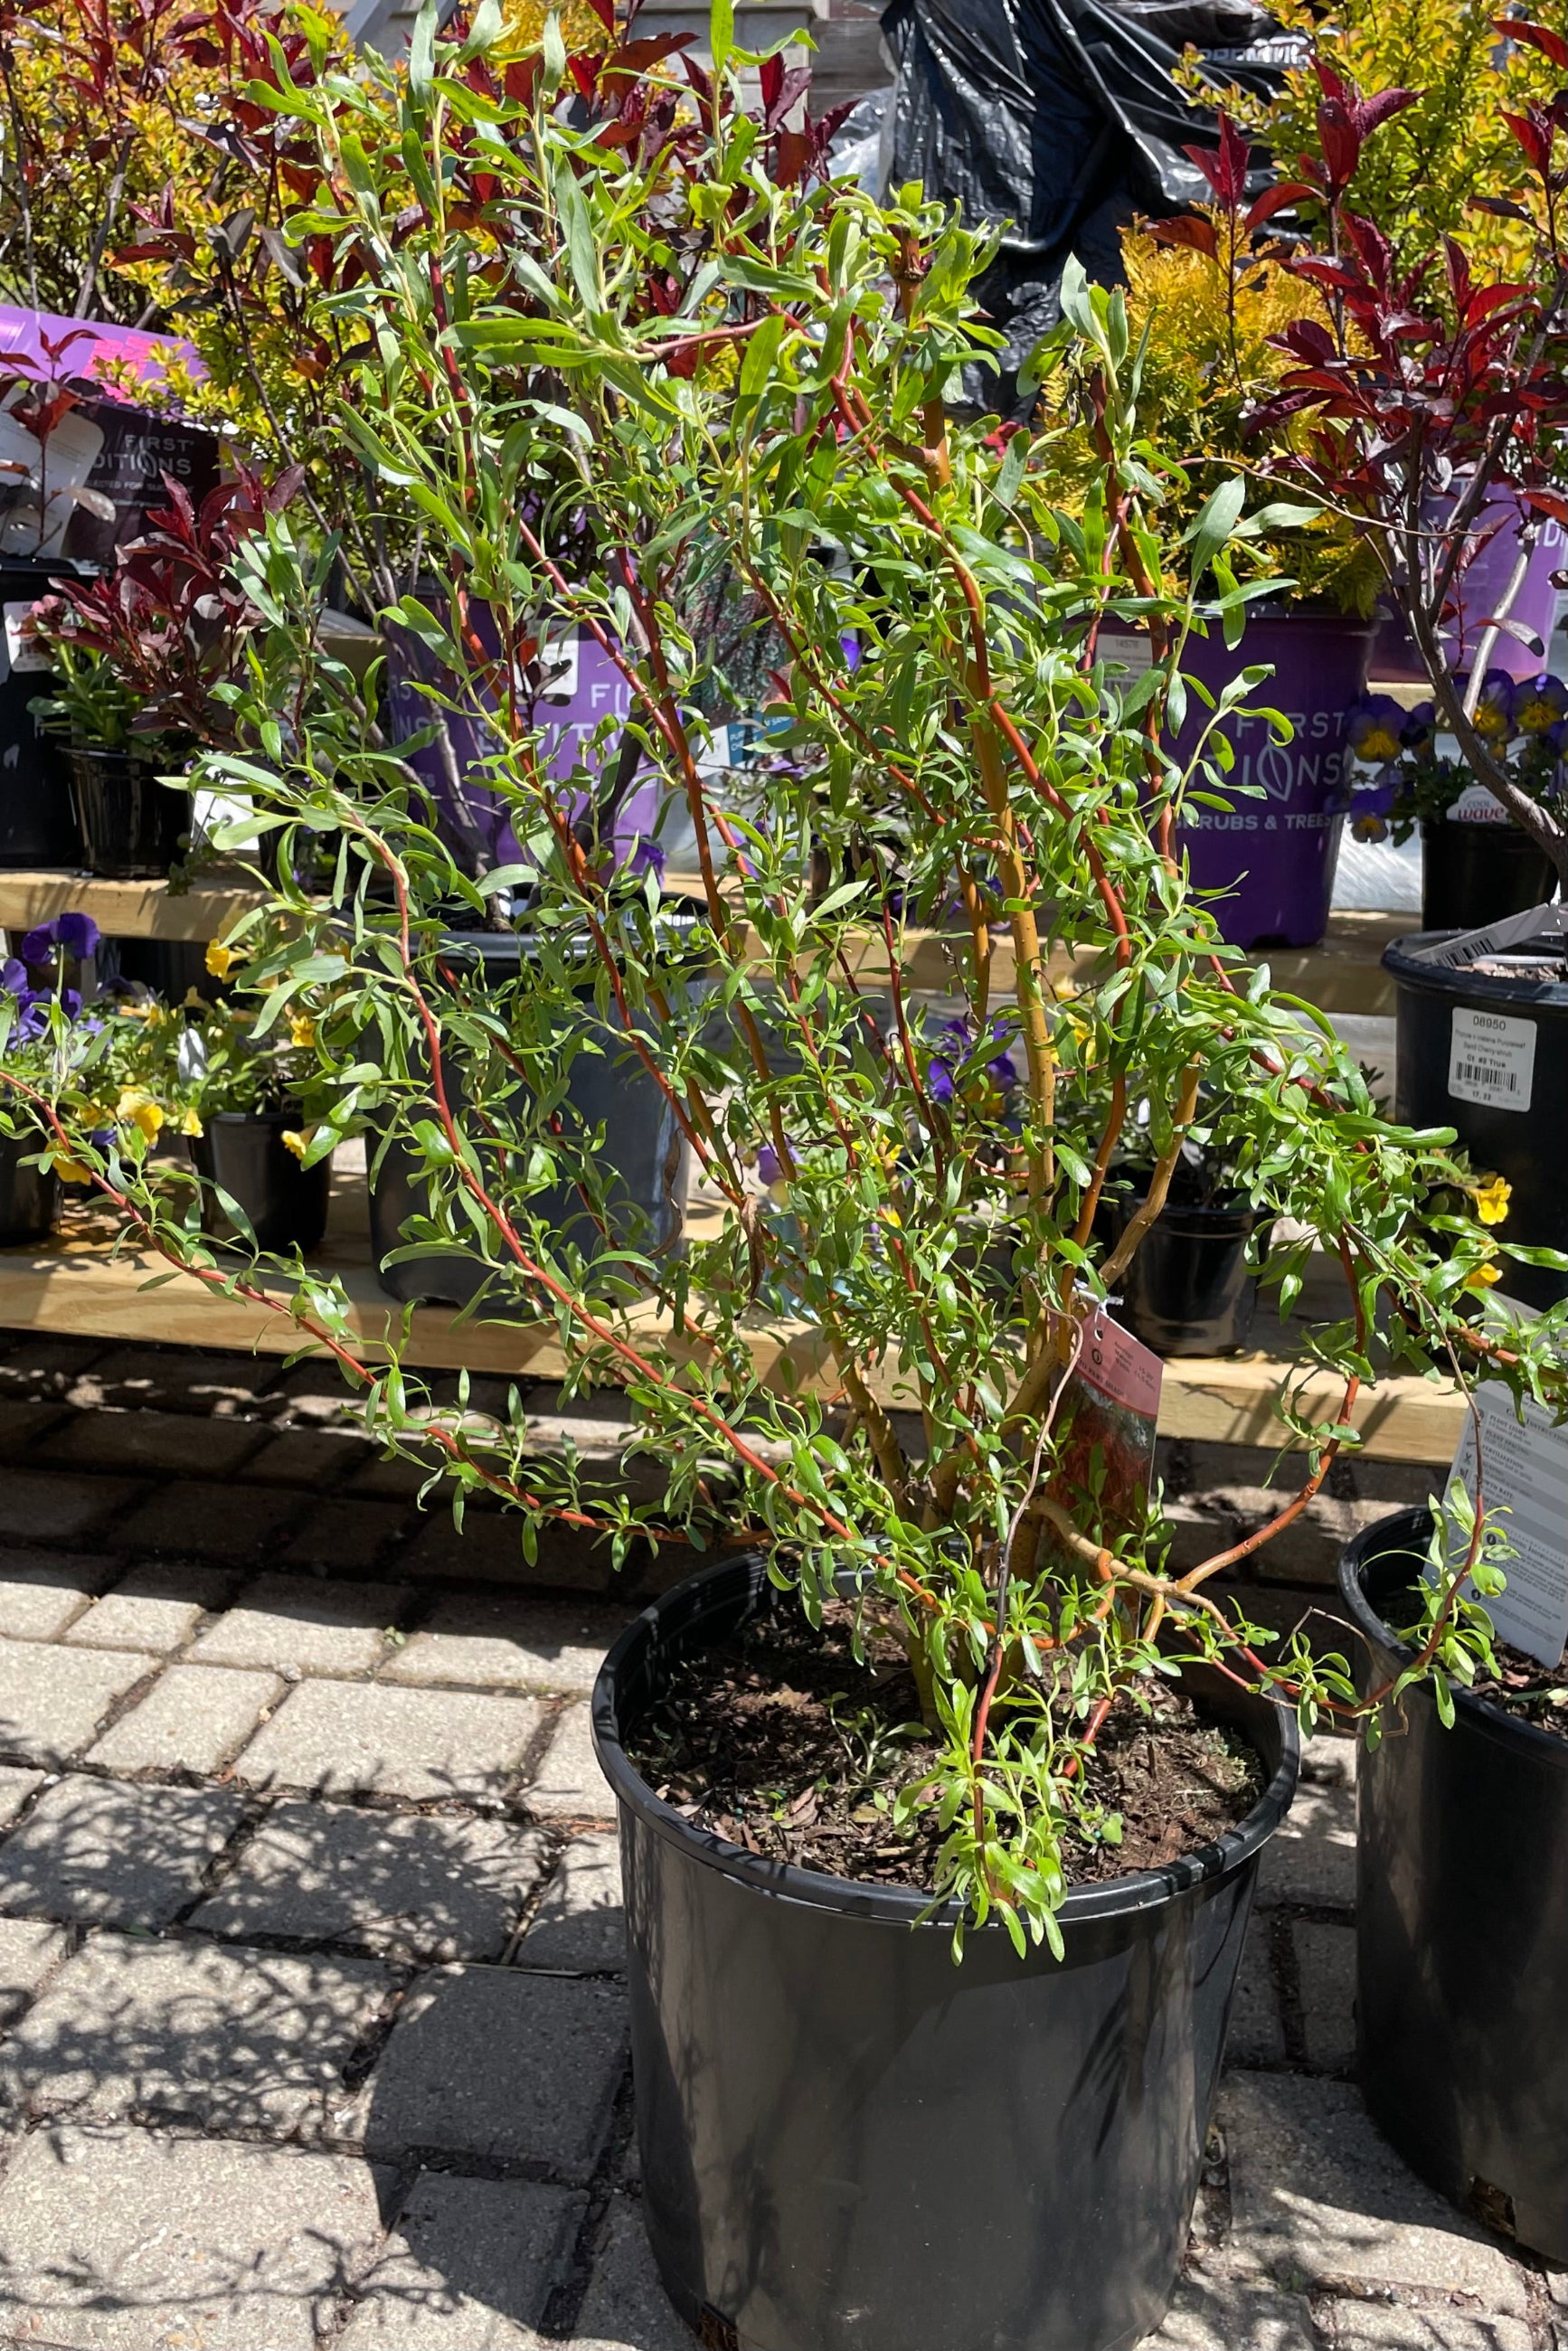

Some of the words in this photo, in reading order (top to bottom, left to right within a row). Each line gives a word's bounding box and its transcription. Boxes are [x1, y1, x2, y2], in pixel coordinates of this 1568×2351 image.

[124, 434, 191, 452] FIRST
[92, 452, 192, 478] DITIONS
[1236, 712, 1345, 739] FIRST
[1264, 815, 1278, 830] &
[1458, 806, 1505, 824] wave
[1472, 1015, 1507, 1032] 08950
